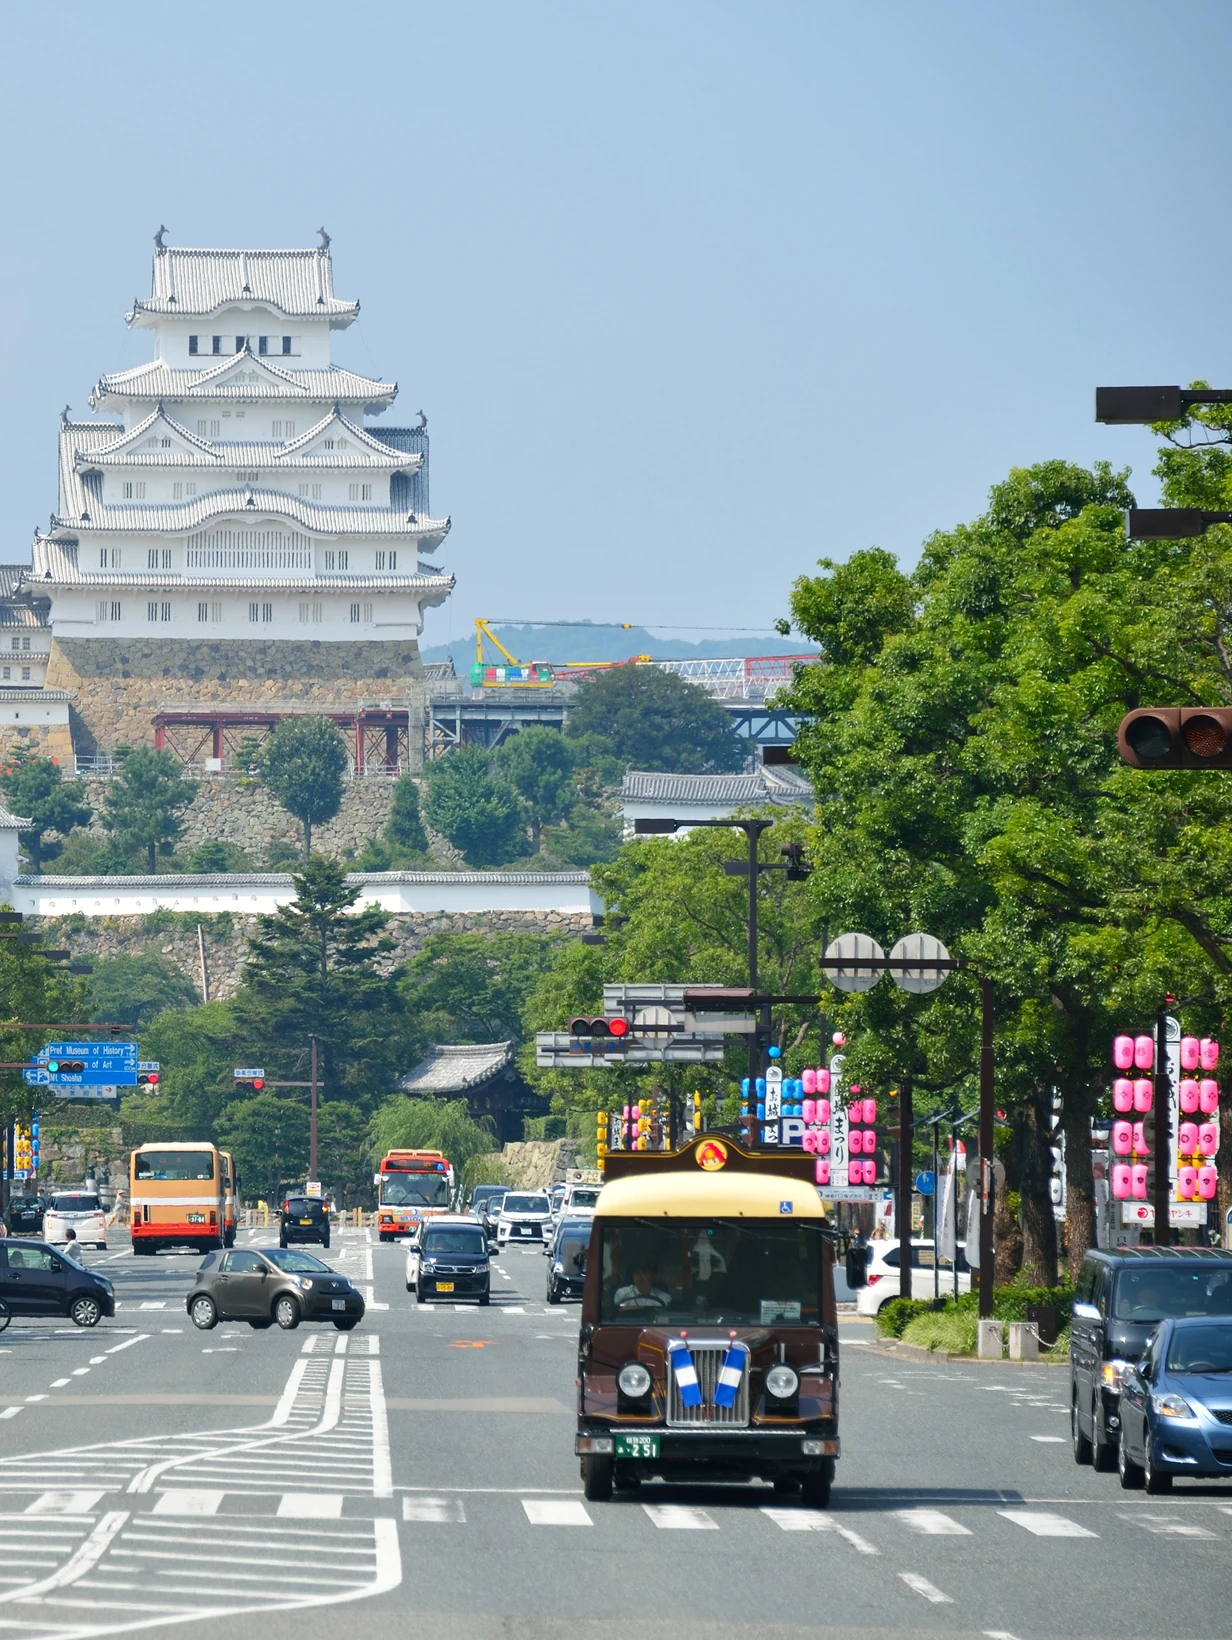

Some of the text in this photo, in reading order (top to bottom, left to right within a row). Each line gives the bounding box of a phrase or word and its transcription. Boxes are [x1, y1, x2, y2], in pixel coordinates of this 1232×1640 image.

[49, 1045, 124, 1057] Pref Museum of History
[91, 1060, 113, 1069] of Art
[61, 1073, 83, 1083] Shosha
[782, 1119, 806, 1144] P
